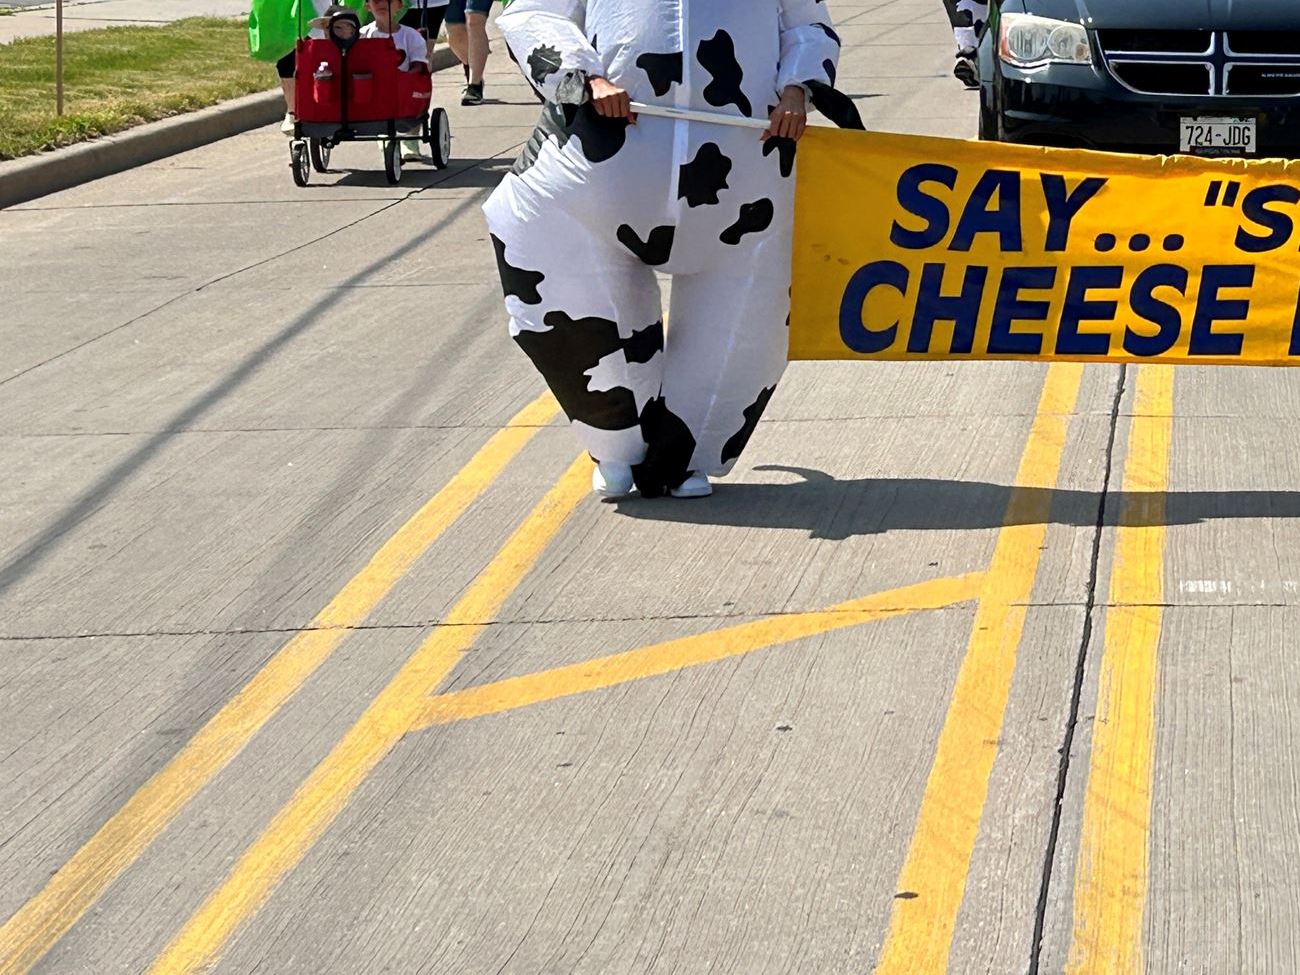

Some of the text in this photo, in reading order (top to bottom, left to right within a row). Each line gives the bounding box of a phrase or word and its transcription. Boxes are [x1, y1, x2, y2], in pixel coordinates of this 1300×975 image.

[1185, 125, 1251, 146] 724-JDG
[890, 163, 1184, 253] SAY...
[838, 260, 1256, 357] CHEESE
